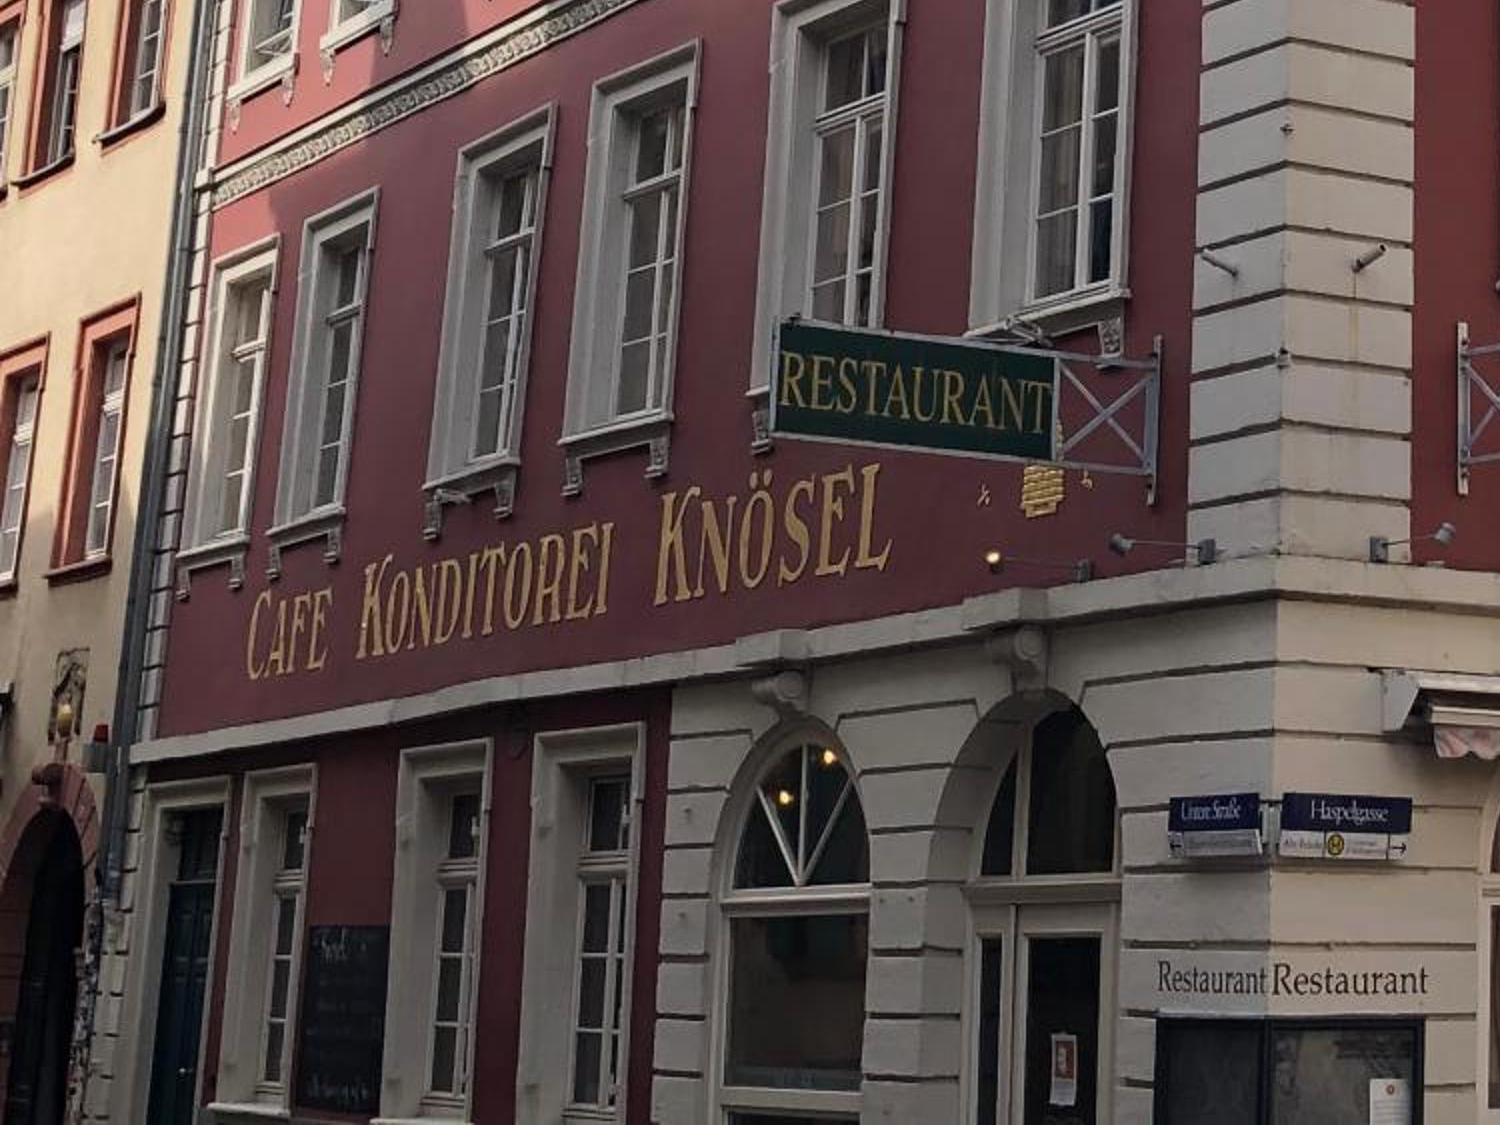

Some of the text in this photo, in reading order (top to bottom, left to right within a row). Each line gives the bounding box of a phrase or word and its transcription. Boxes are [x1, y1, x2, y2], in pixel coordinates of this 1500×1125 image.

[779, 350, 1053, 435] RESTAURANT
[247, 462, 893, 680] CAFE KONDITOREI KNÖSEL
[1311, 799, 1390, 824] Haspelgasse
[1157, 960, 1268, 994] Restaurant
[1271, 962, 1429, 996] Restaurant
